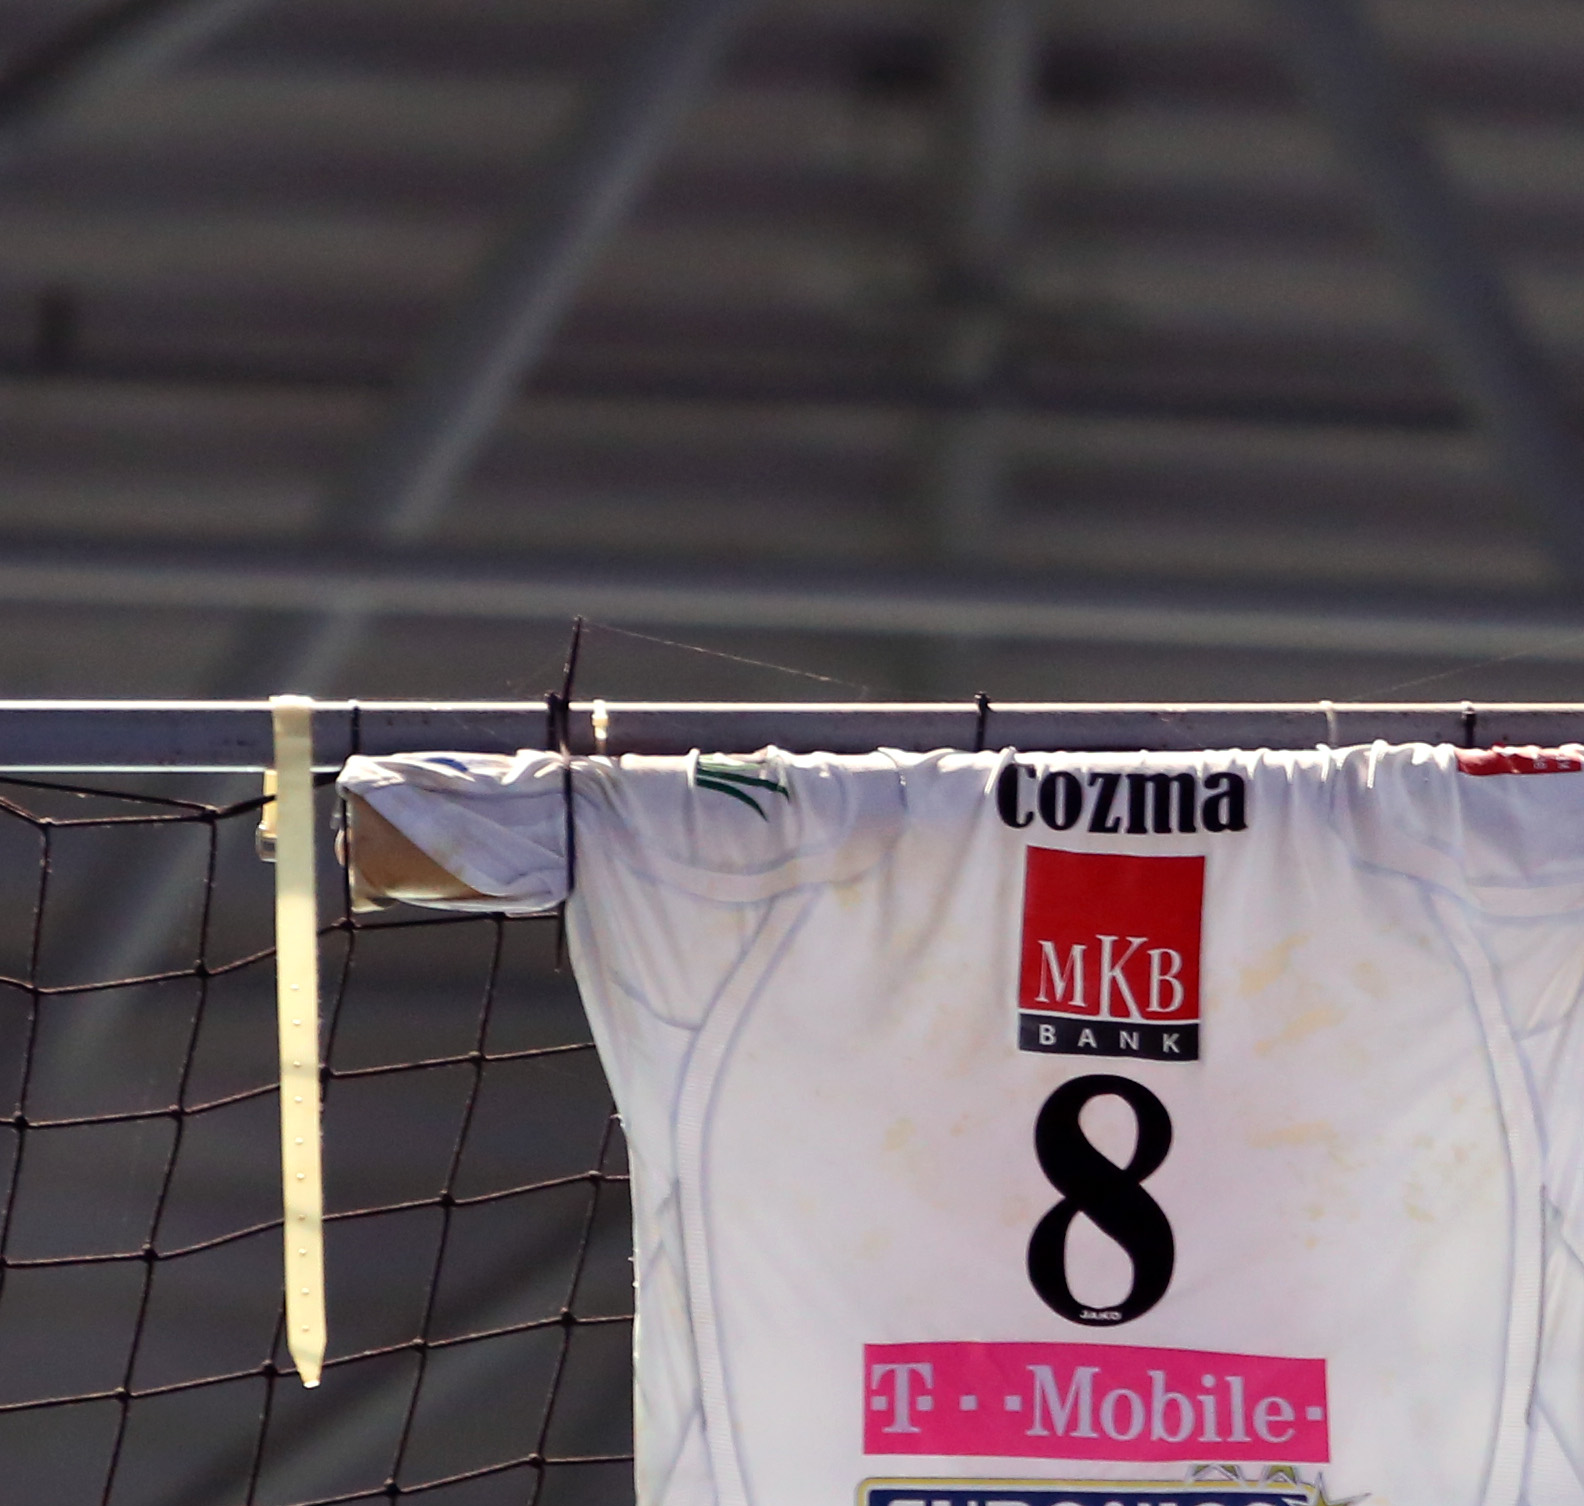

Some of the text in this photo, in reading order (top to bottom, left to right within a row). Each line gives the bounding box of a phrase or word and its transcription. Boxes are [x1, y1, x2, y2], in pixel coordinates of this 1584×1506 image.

[996, 763, 1248, 834] Cozma
[1034, 934, 1185, 1021] MKB
[1038, 1024, 1181, 1053] BANK
[1027, 1073, 1175, 1327] 8
